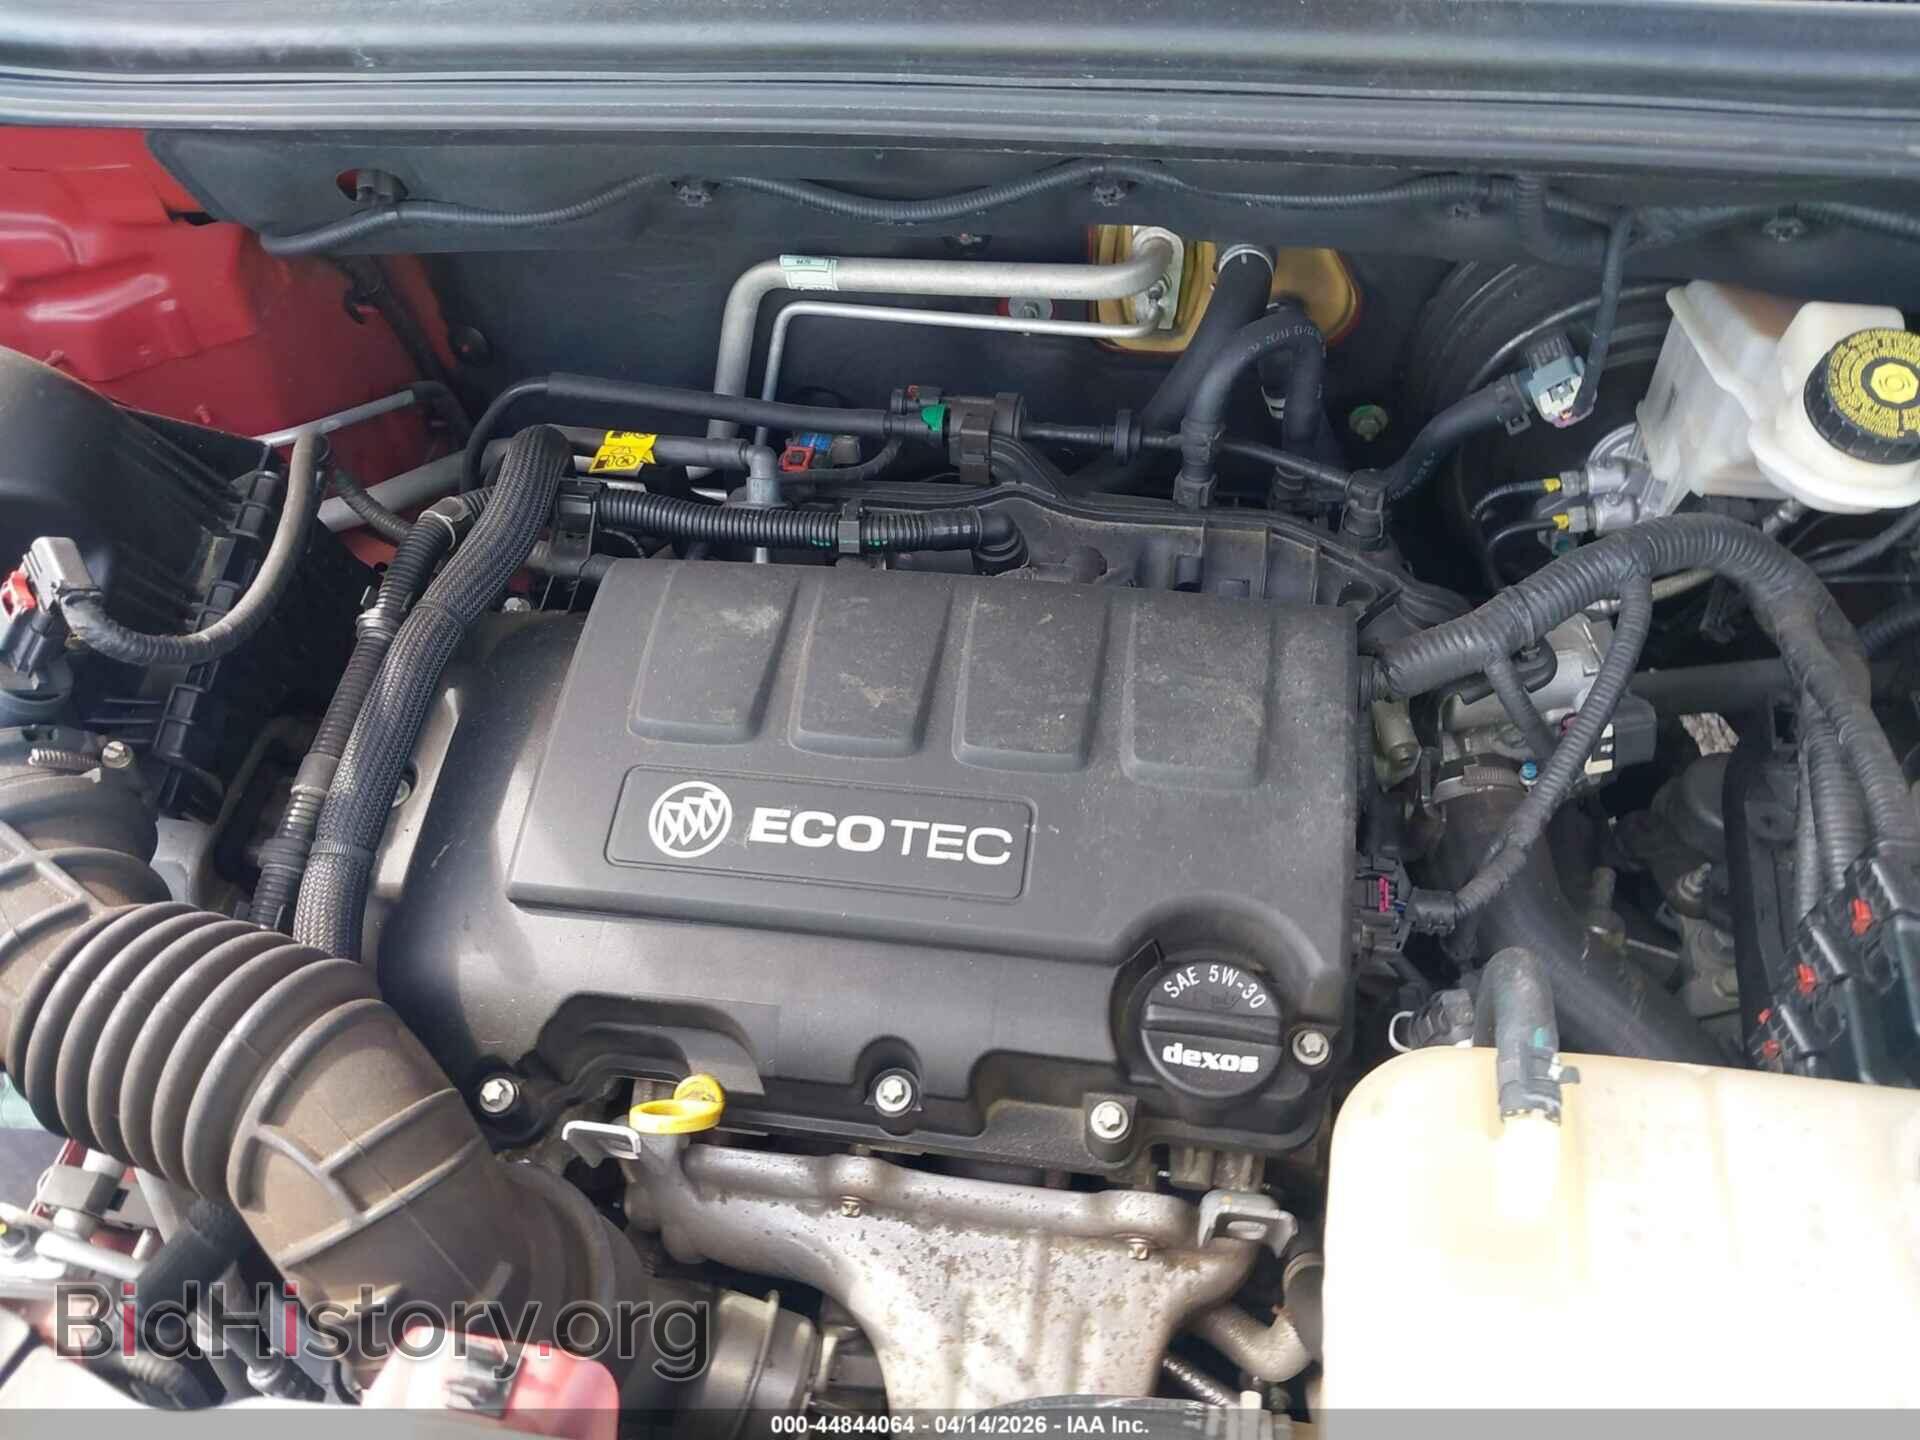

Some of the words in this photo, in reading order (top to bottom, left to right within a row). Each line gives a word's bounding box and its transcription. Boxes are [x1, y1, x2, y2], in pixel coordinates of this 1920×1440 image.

[749, 807, 1014, 865] ECOTEC
[1163, 966, 1201, 998] SAE
[1208, 964, 1267, 1009] 5W-30
[1162, 1042, 1259, 1073] dexos
